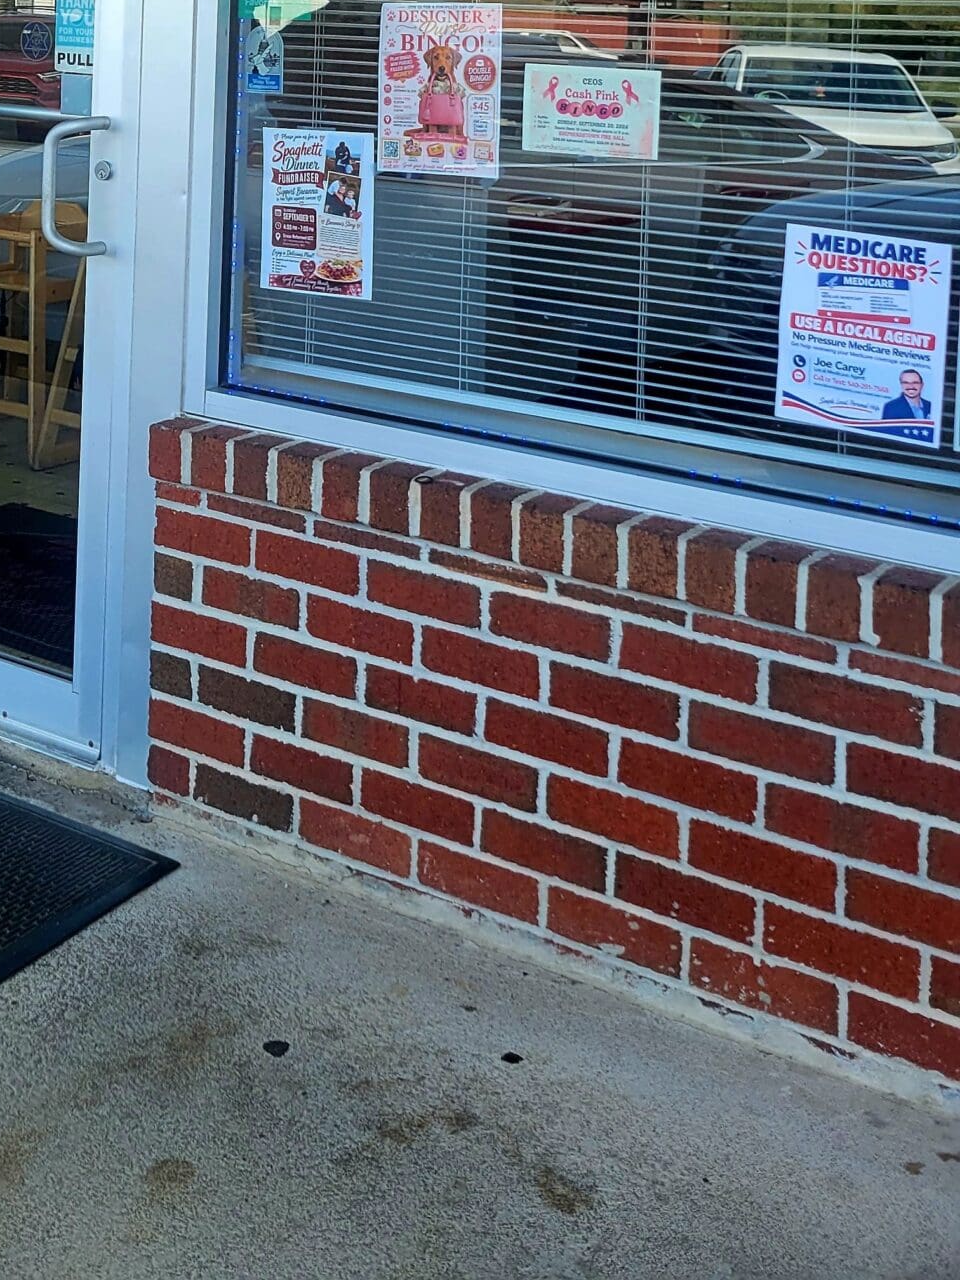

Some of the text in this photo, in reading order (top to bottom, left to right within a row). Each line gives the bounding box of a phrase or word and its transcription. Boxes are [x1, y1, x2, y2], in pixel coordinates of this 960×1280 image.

[398, 10, 484, 23] DESIGNER
[419, 20, 469, 36] Purse
[401, 33, 485, 53] BINGO!
[57, 52, 93, 67] PULL
[468, 67, 491, 75] DOUBLE
[582, 78, 603, 86] CEOS
[565, 88, 620, 101] Cash Pink
[472, 102, 490, 112] $45
[272, 140, 323, 165] Spaghetti
[281, 156, 320, 172] Dinner
[278, 172, 319, 184] FUNDRAISER
[276, 186, 295, 197] Support
[283, 213, 308, 222] SEPTEMBER
[811, 233, 927, 265] MEDICARE
[808, 251, 928, 282] QUESTIONS?
[843, 276, 895, 288] MEDICARE
[794, 315, 931, 348] USE A LOCAL AGENT
[792, 331, 932, 362] No Pressure Medicare Reviews
[814, 357, 866, 376] Joe Carey
